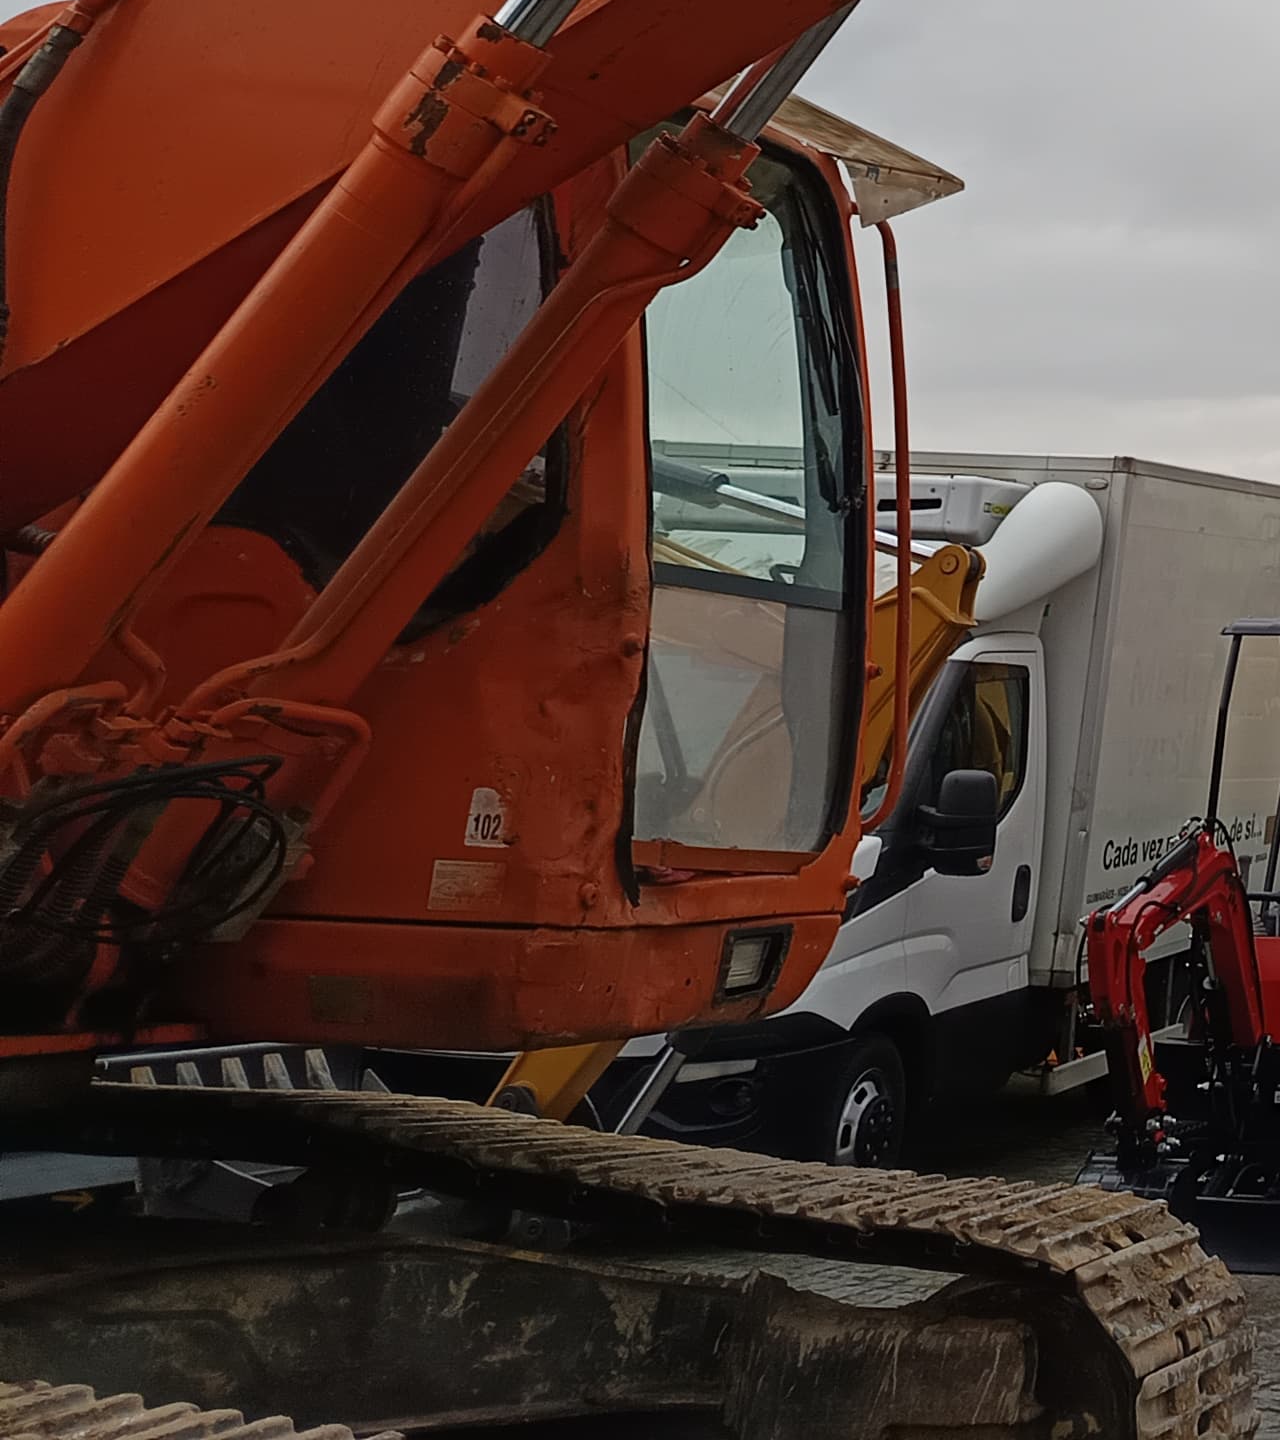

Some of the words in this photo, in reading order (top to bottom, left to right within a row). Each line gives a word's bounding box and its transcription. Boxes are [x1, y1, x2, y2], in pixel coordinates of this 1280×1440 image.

[473, 814, 502, 840] 102
[1103, 837, 1138, 870] Cada
[1142, 837, 1164, 859] vez
[1230, 816, 1243, 842] de
